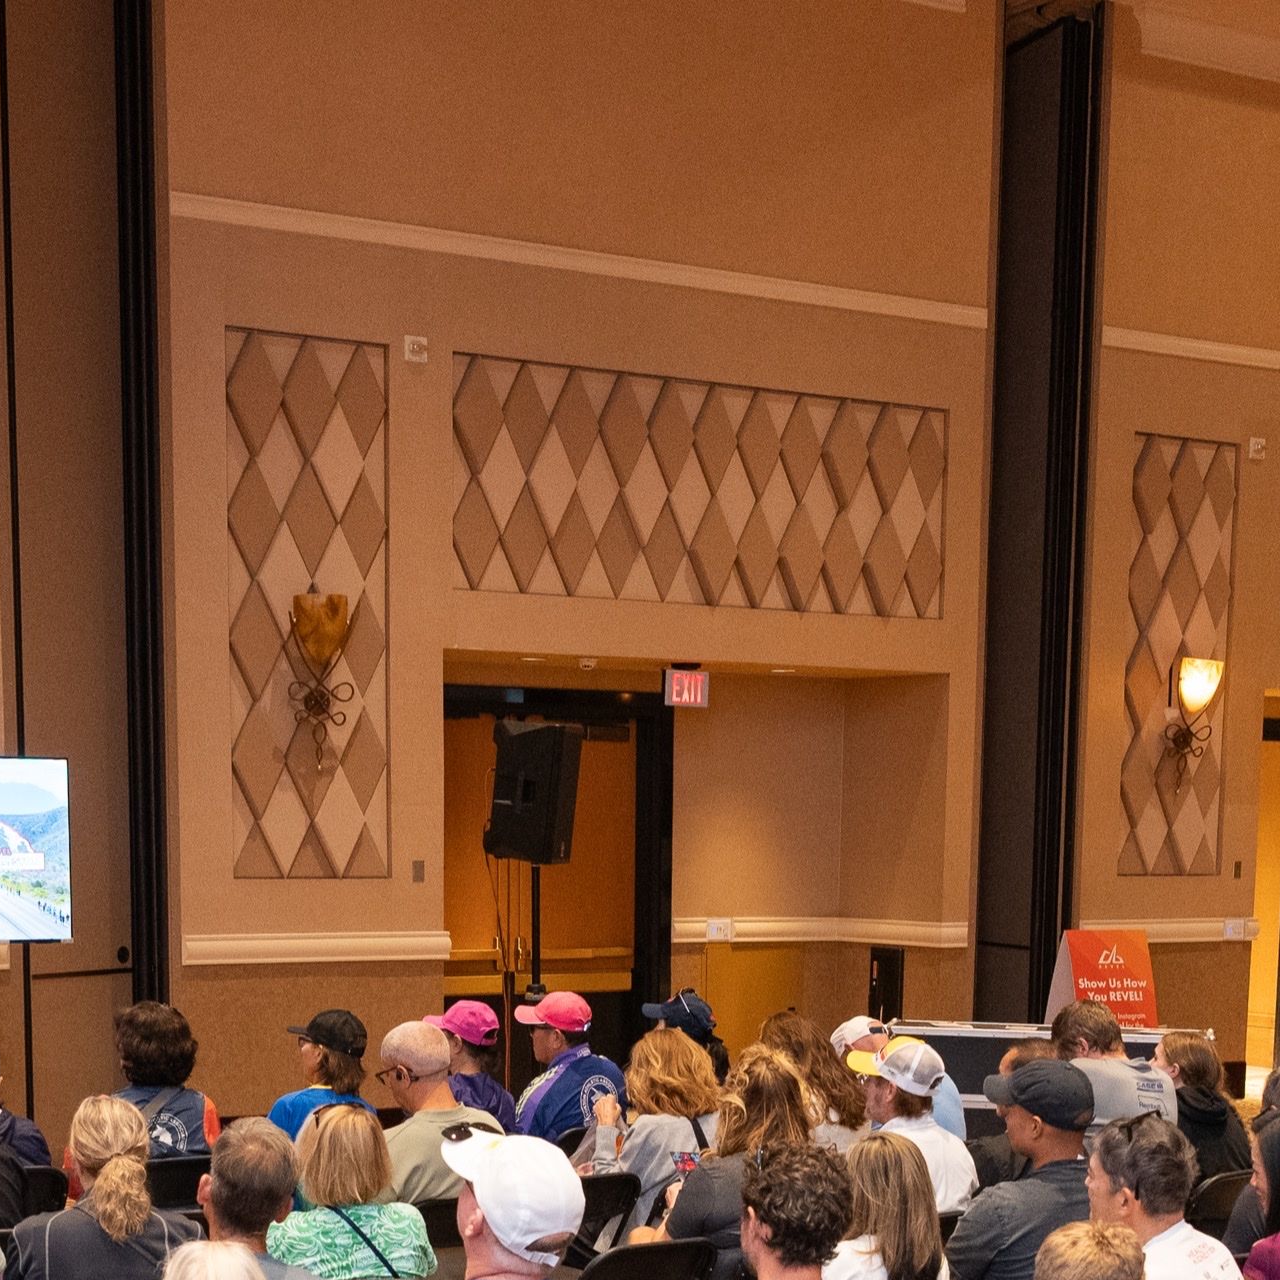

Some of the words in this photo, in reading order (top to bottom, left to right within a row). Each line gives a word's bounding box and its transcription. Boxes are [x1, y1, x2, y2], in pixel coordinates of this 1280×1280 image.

[672, 672, 704, 703] EXIT
[1078, 978, 1106, 988] Show
[1109, 978, 1121, 988] Us
[1123, 978, 1147, 988] How
[1087, 991, 1107, 1001] You
[1109, 991, 1143, 1001] REVEL!
[1117, 1012, 1146, 1021] Instagram
